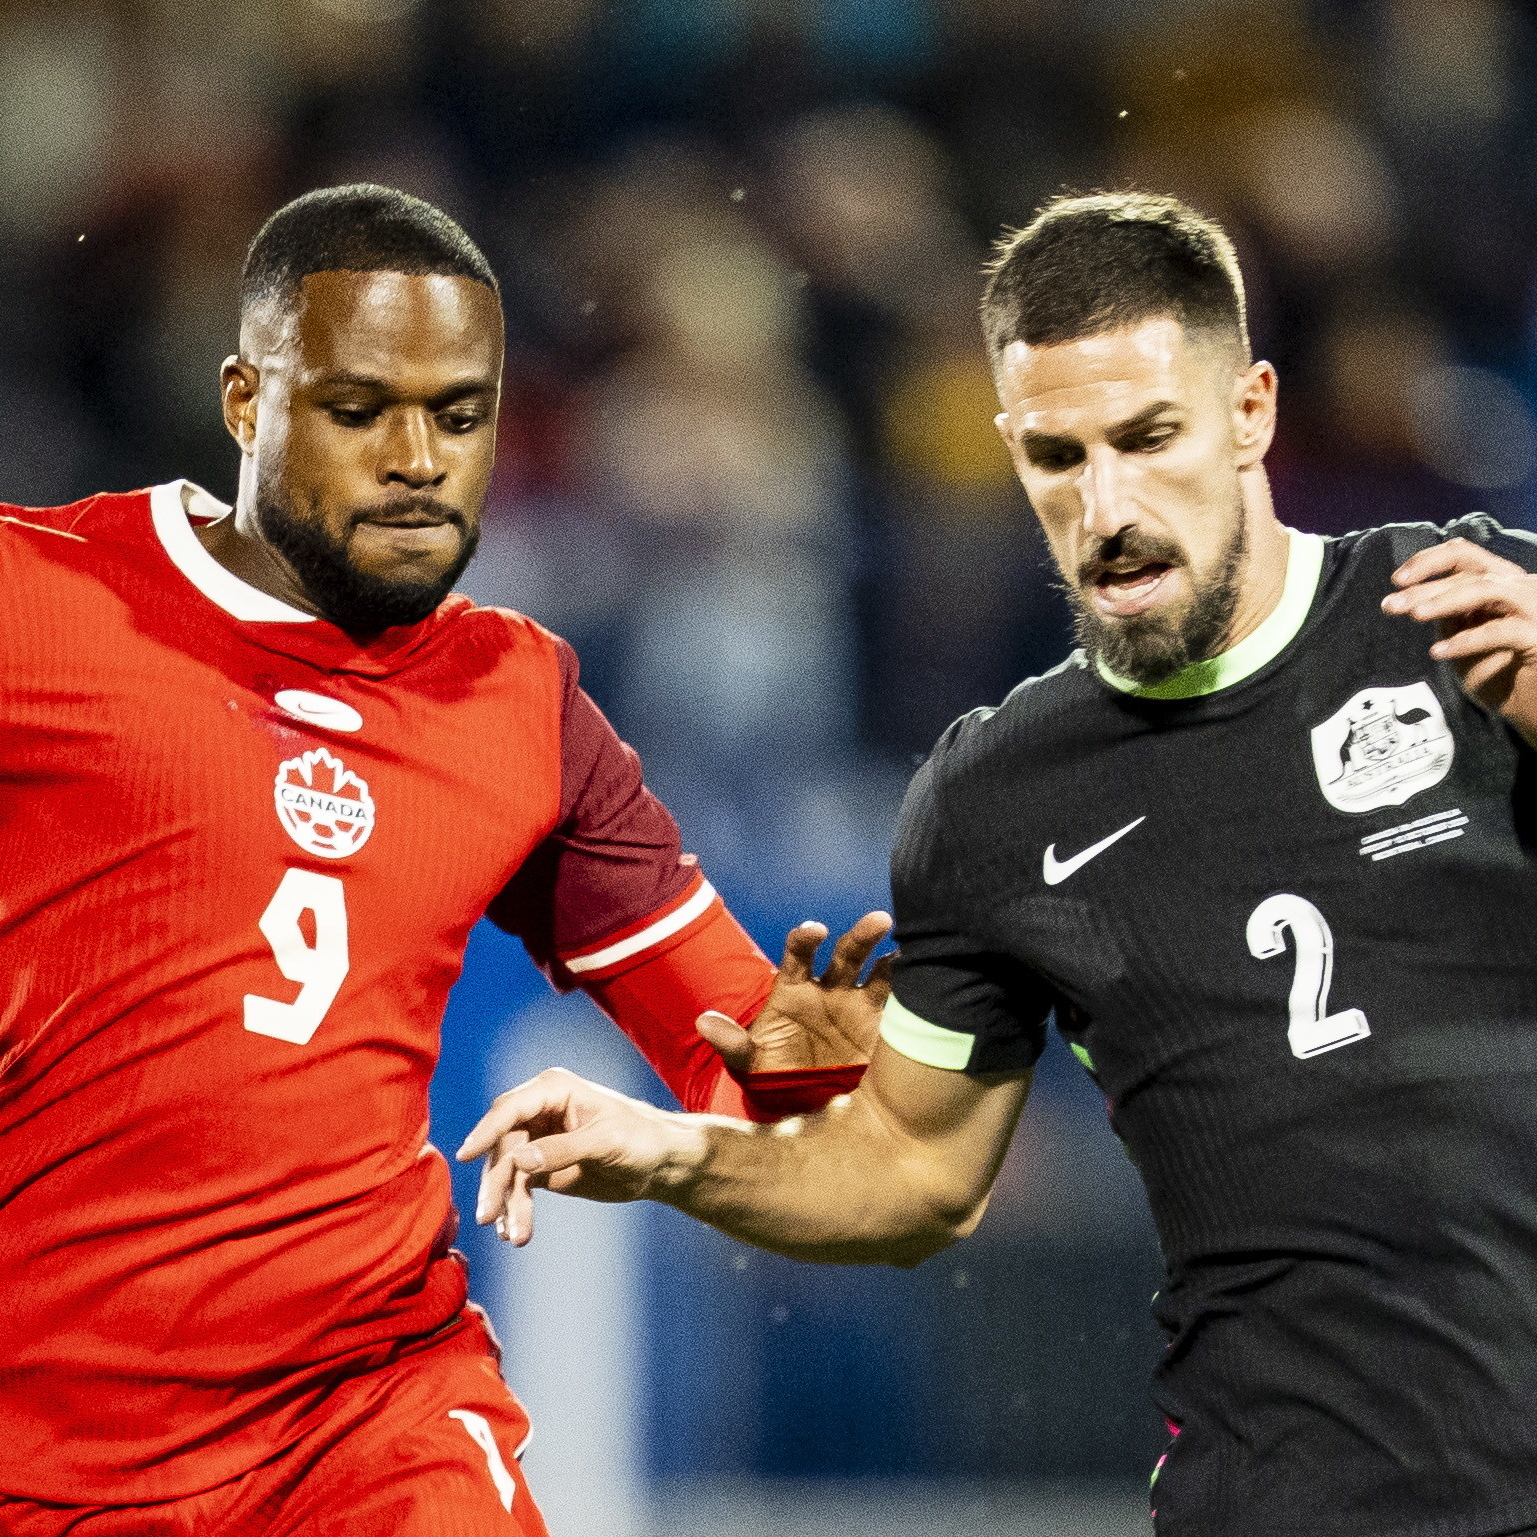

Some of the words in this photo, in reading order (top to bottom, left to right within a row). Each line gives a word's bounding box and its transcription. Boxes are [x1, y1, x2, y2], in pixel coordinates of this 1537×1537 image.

[281, 788, 367, 821] CANADA
[243, 867, 349, 1045] 9
[1246, 893, 1371, 1060] 2
